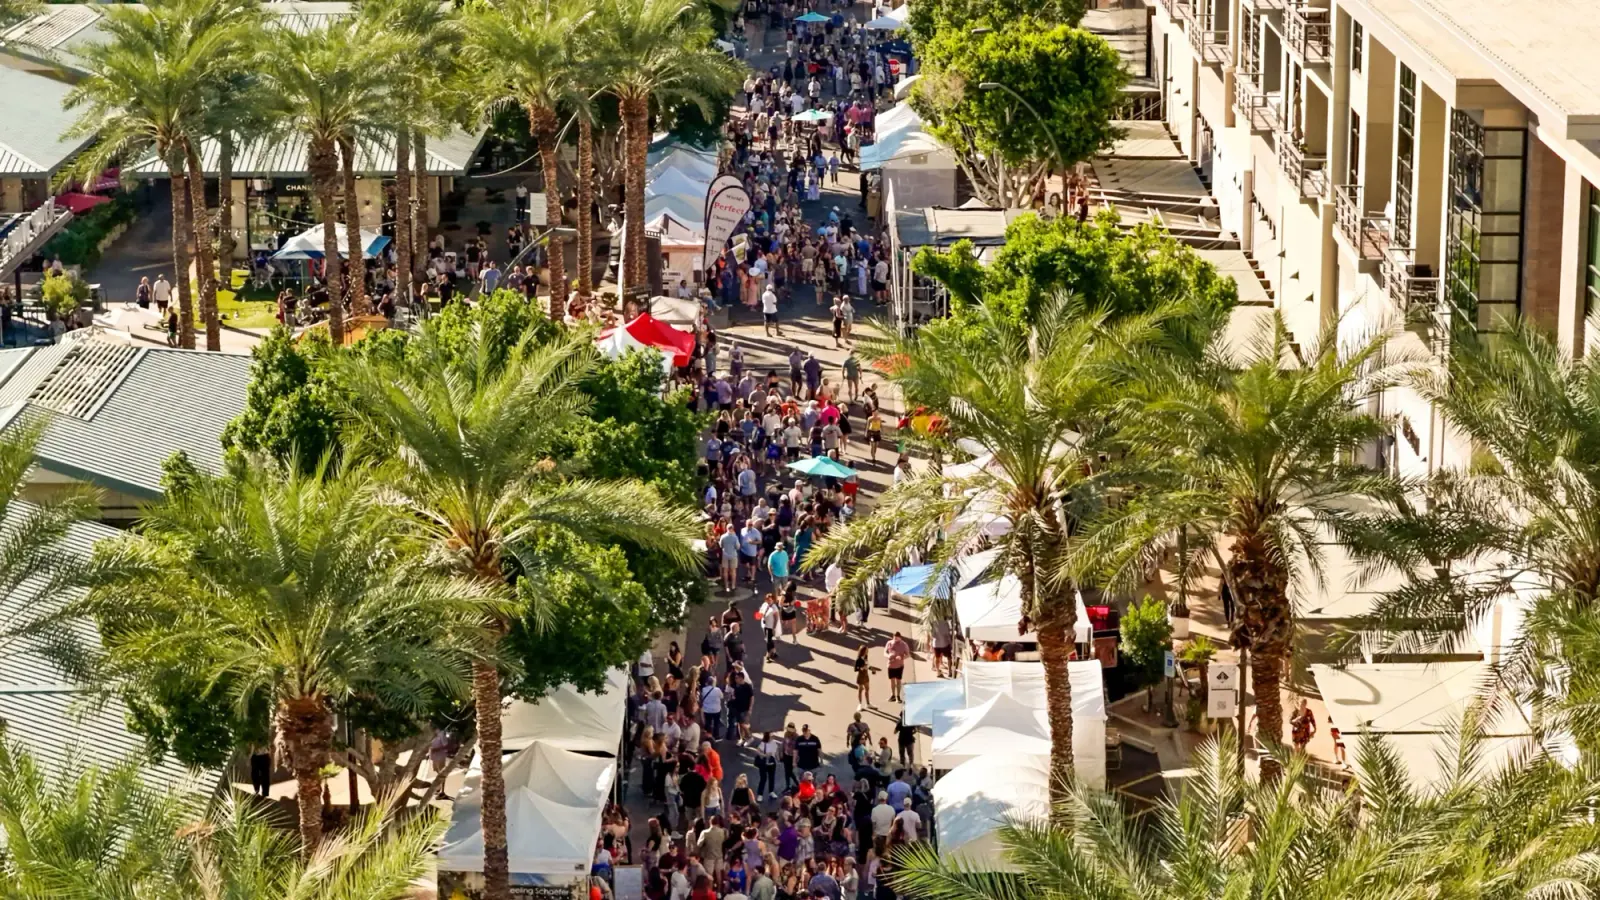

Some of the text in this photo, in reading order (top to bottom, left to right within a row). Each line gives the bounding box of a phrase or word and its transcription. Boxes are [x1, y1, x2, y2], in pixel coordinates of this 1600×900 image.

[714, 201, 744, 214] Perfect
[510, 887, 568, 896] eeling Schaefer
